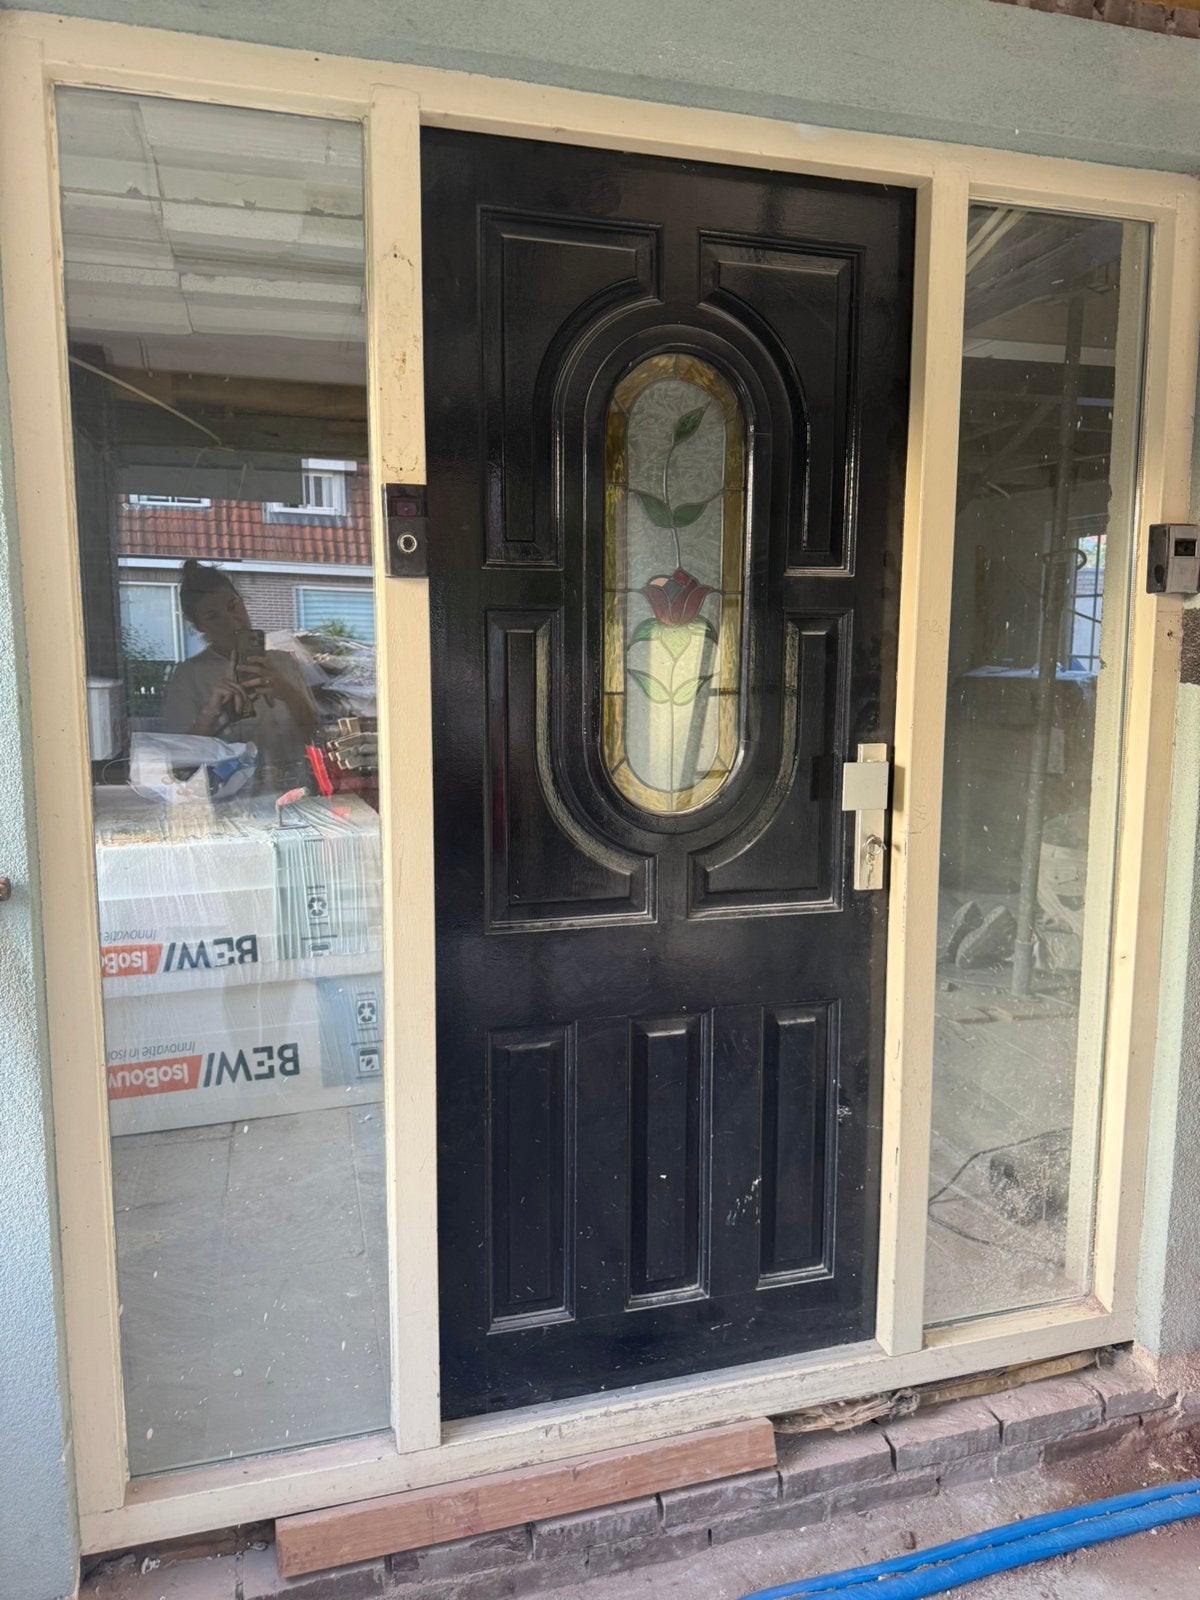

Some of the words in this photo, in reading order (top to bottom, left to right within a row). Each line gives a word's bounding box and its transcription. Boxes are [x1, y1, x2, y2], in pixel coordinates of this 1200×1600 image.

[104, 929, 157, 942] Innovatie
[101, 950, 148, 975] IsoB
[163, 934, 259, 973] BEWI
[128, 1047, 140, 1059] in
[142, 1041, 196, 1057] Innovatie
[202, 1042, 300, 1088] BEWI
